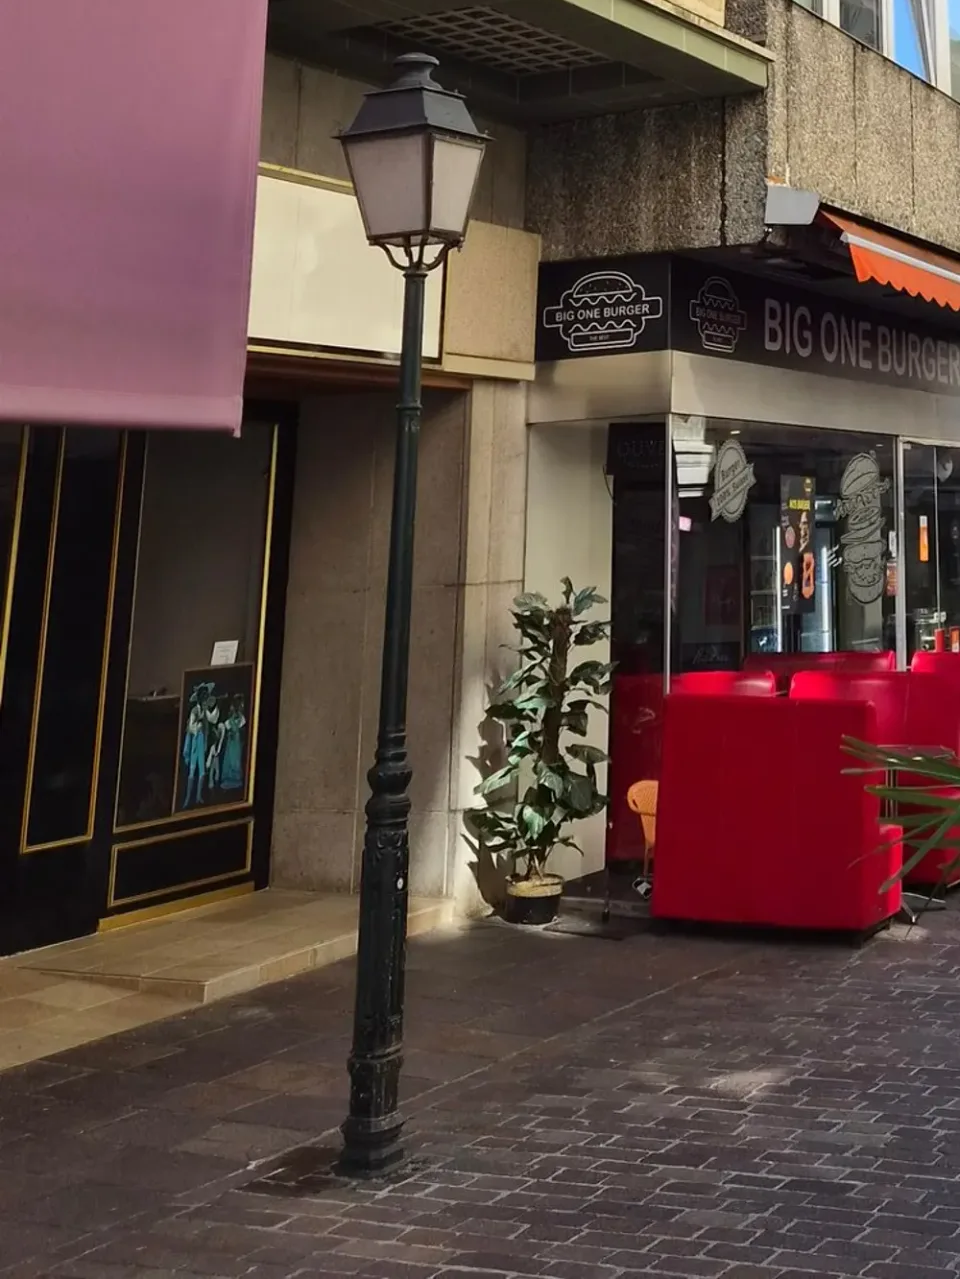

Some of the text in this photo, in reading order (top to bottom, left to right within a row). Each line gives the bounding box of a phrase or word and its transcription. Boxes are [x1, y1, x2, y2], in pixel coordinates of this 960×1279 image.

[555, 303, 650, 322] BIG ONE BURGER
[764, 298, 813, 358] BIG
[820, 311, 872, 370] ONE
